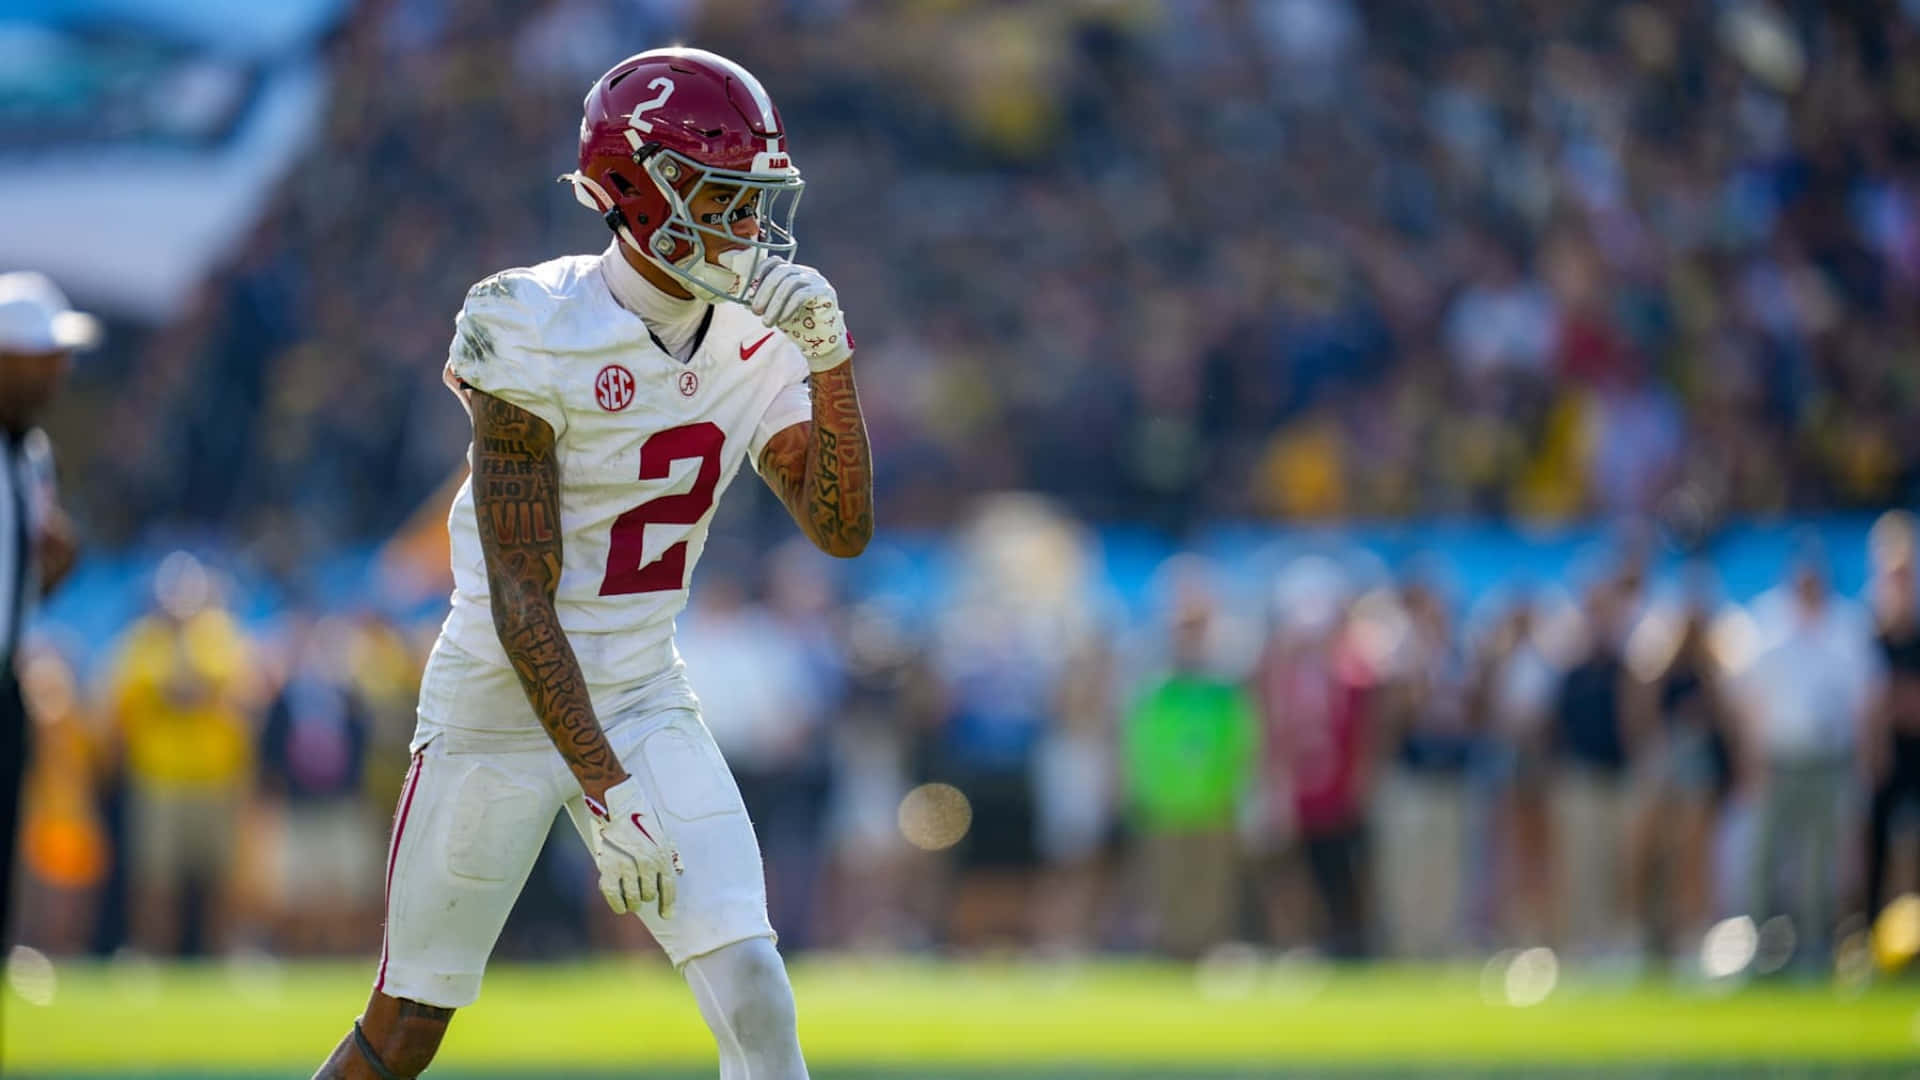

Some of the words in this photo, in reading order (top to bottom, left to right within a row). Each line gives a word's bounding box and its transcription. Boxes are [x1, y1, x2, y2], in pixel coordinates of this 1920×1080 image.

[628, 77, 674, 133] 2
[596, 365, 634, 412] SEC
[483, 436, 526, 453] WILL
[481, 457, 533, 475] FEAR
[488, 480, 521, 497] NO
[599, 421, 726, 596] 2
